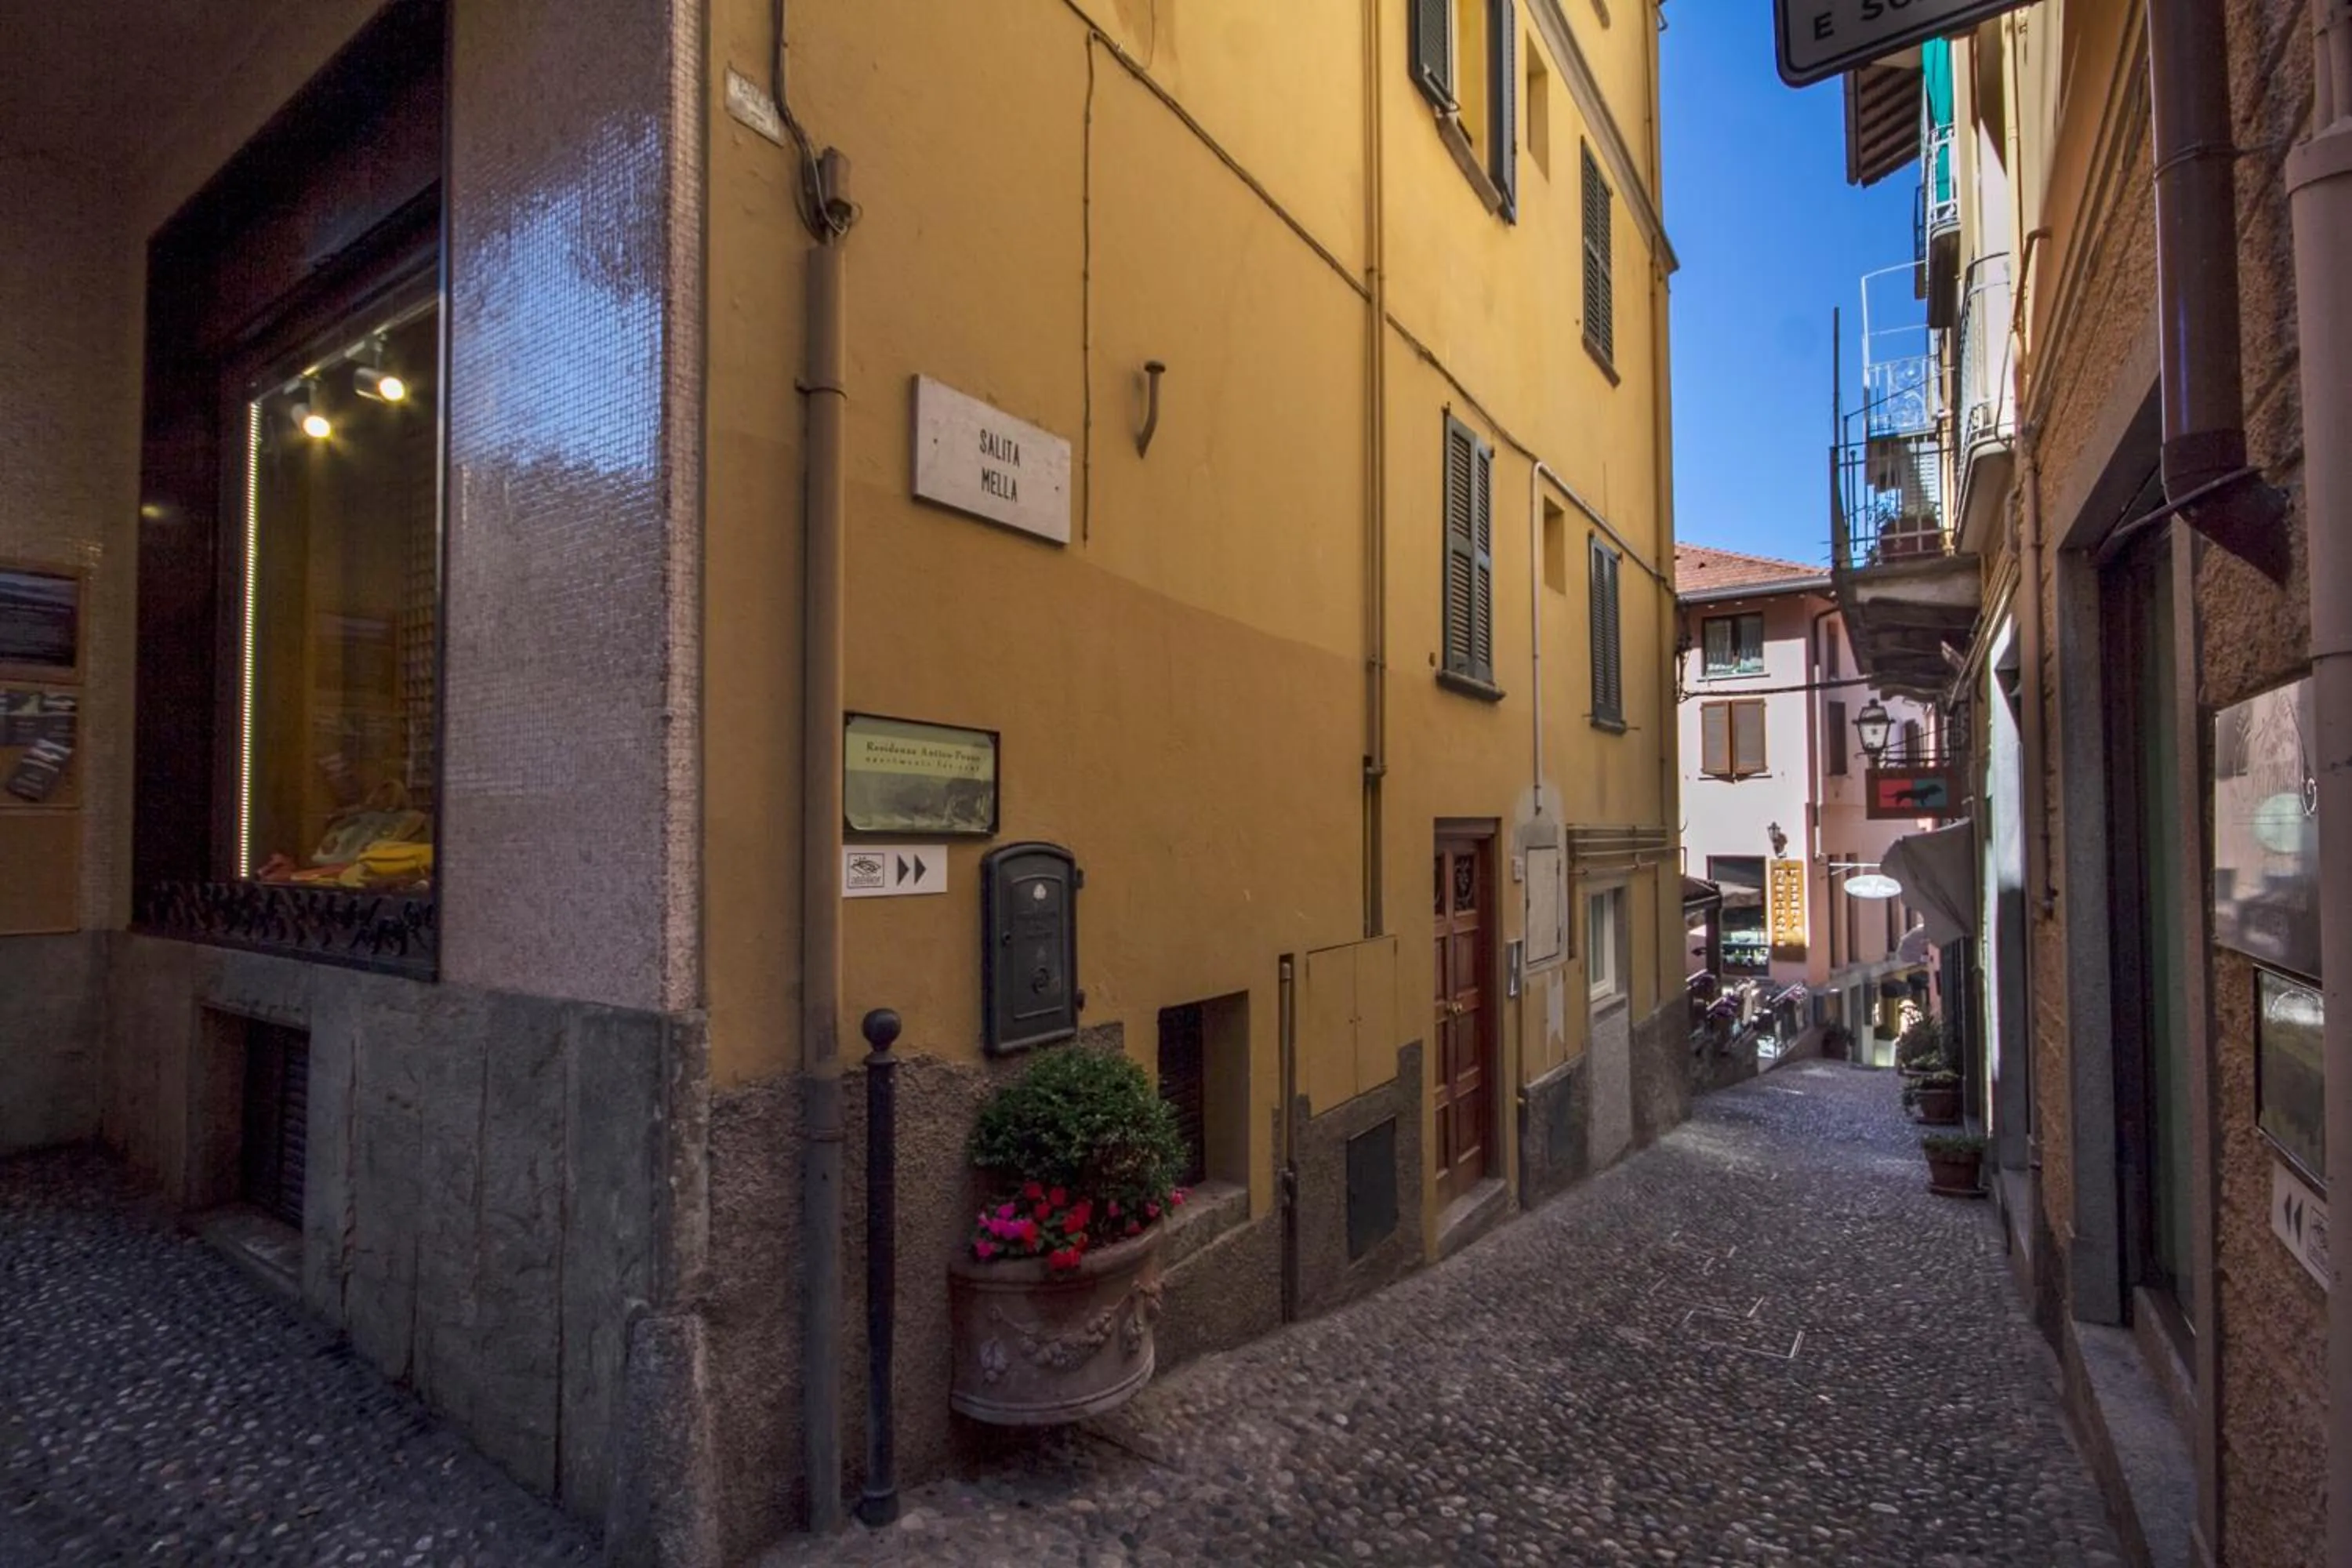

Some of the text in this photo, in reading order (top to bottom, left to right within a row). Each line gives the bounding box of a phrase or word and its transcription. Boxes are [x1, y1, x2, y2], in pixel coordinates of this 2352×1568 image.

[1813, 11, 1835, 42] E
[979, 428, 1020, 467] SALITA
[981, 466, 1018, 503] MELLA
